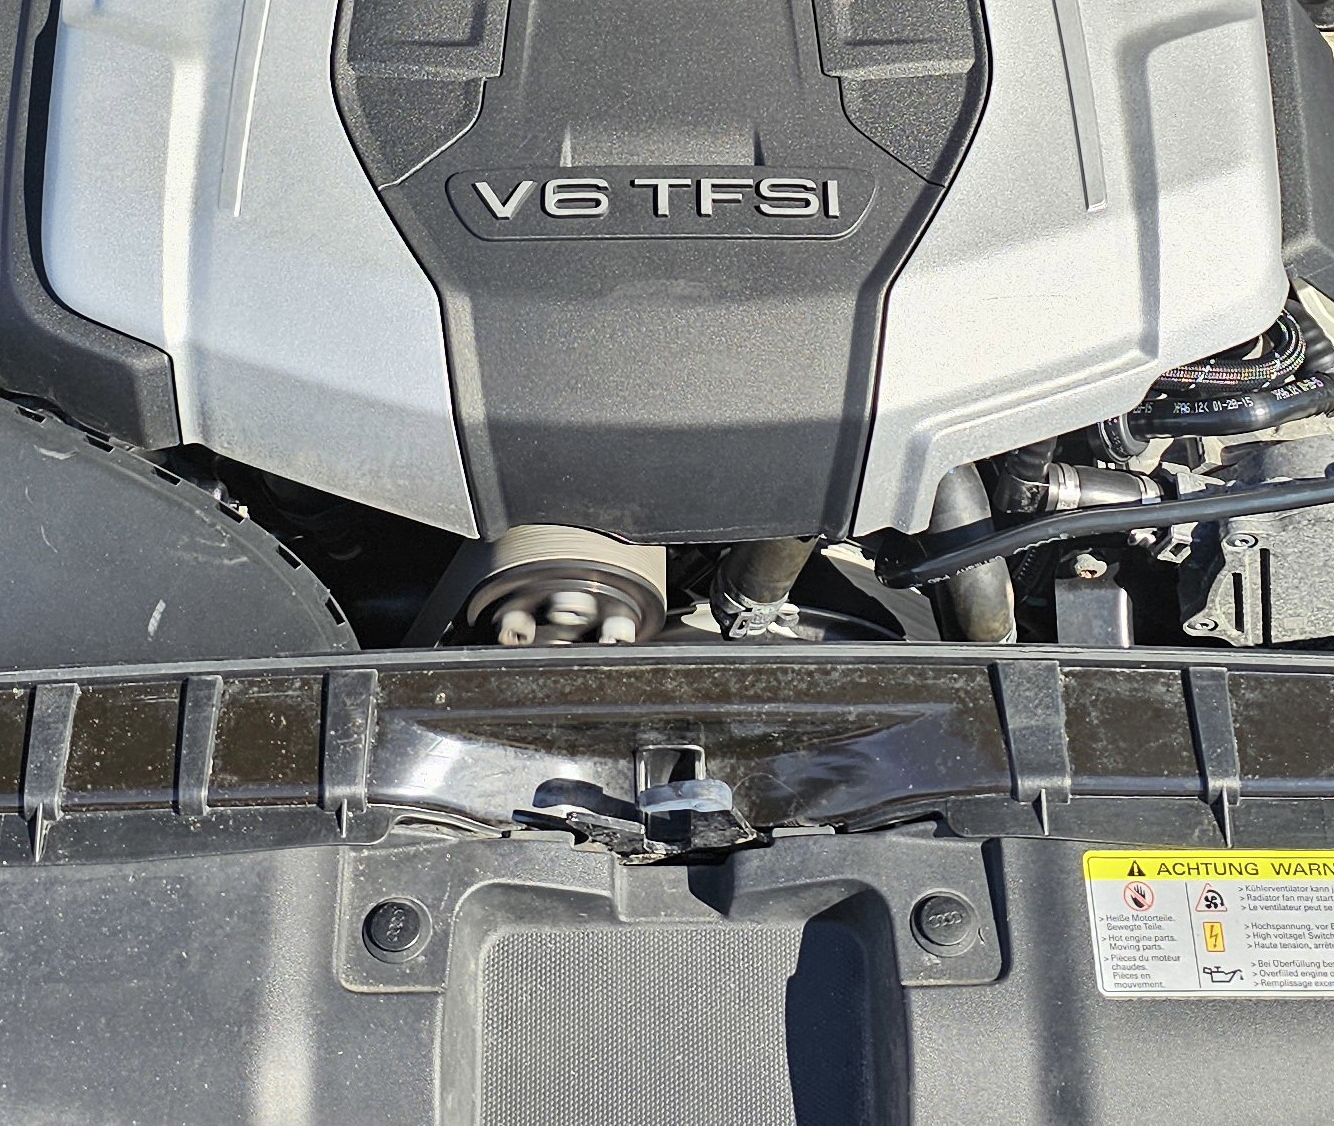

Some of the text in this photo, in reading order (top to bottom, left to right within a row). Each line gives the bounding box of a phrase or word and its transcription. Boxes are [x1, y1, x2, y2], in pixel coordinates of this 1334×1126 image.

[472, 177, 840, 221] V6 TFSI
[1157, 862, 1259, 876] ACHTUNG
[1245, 885, 1308, 893] Kühlerventilator
[1247, 894, 1280, 902] Radiator
[1304, 905, 1322, 913] peut
[1105, 914, 1176, 922] Heiße Motorteile.
[1107, 923, 1142, 932] Bewegte
[1109, 934, 1123, 942] Hot
[1124, 935, 1153, 944] engine
[1252, 932, 1272, 941] High
[1110, 943, 1141, 952] Moving
[1254, 941, 1278, 949] Haute
[1138, 954, 1149, 962] du
[1258, 959, 1271, 968] Bei
[1300, 970, 1328, 979] engine
